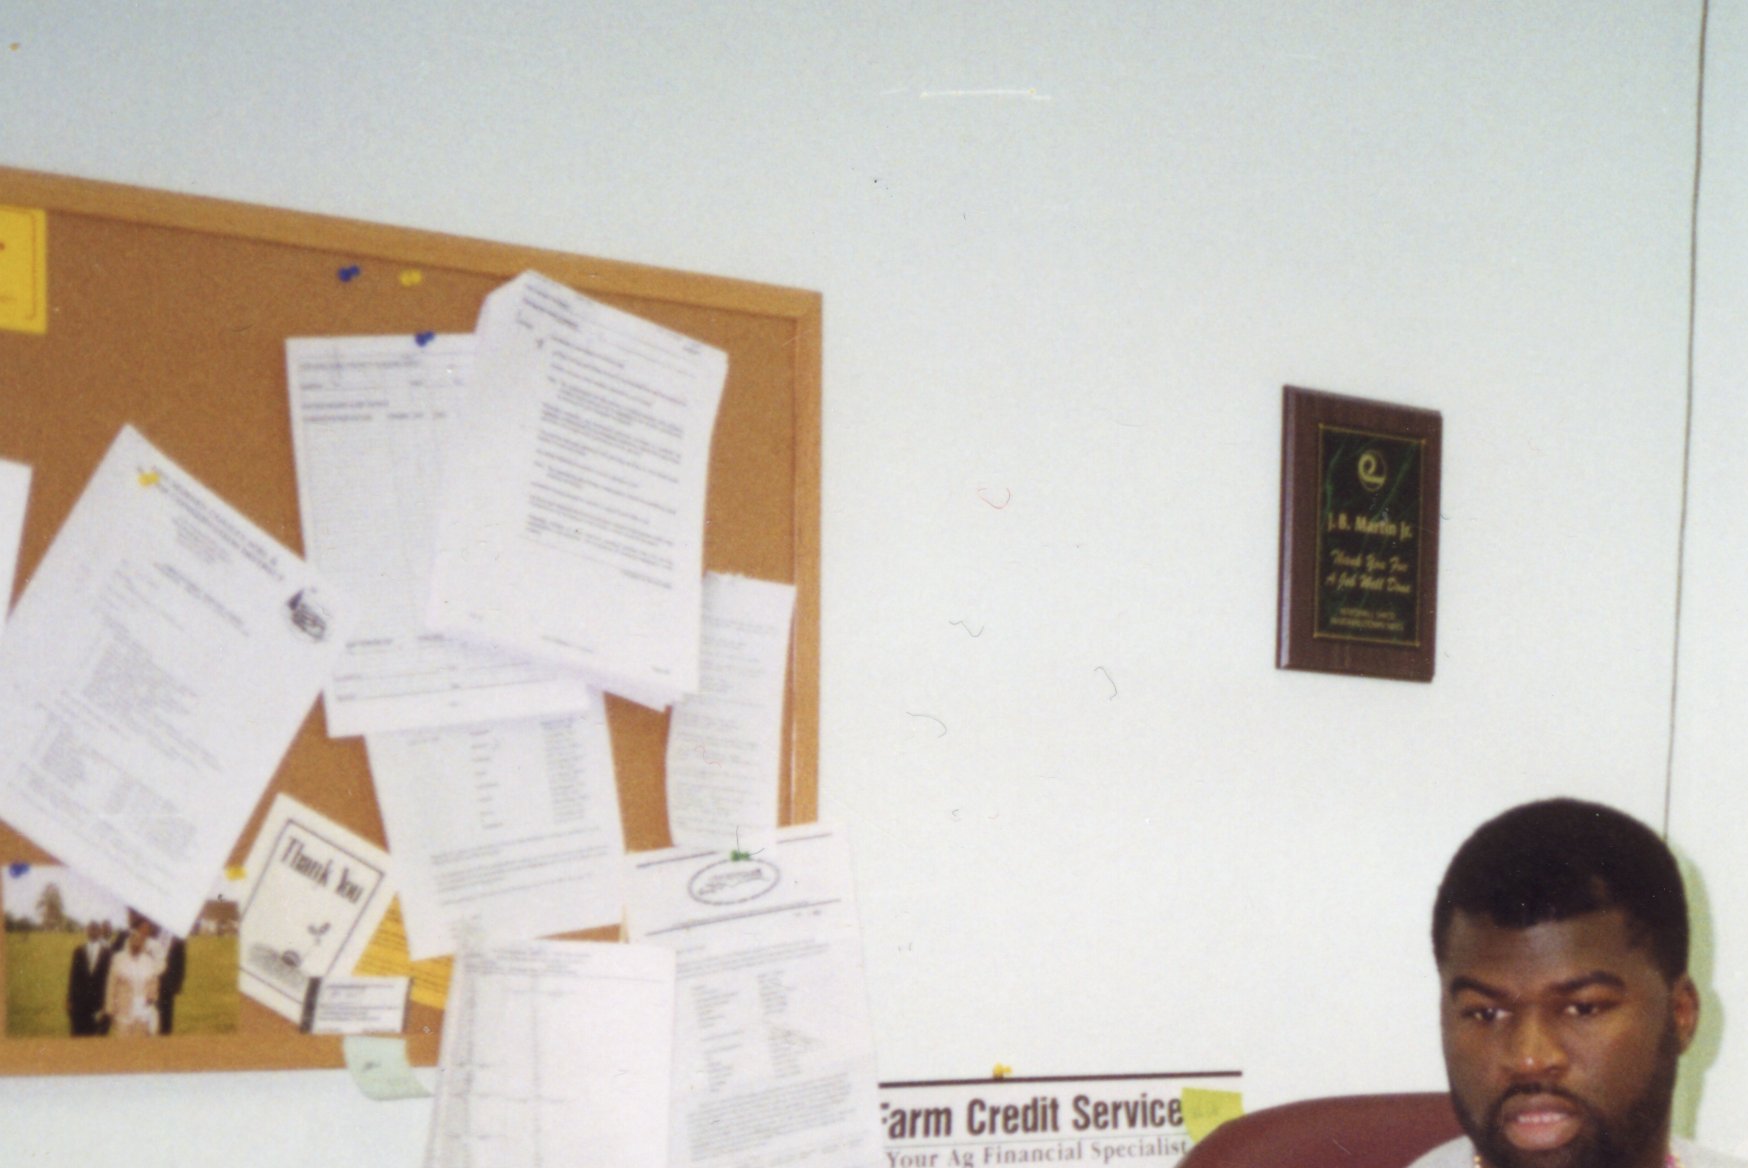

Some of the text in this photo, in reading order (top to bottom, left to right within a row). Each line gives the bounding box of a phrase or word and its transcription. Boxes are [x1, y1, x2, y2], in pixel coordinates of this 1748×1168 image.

[281, 836, 365, 908] Thank You
[967, 1096, 1060, 1136] Credit
[984, 1139, 1083, 1165] Financial
[1092, 1137, 1189, 1160] Specialist
